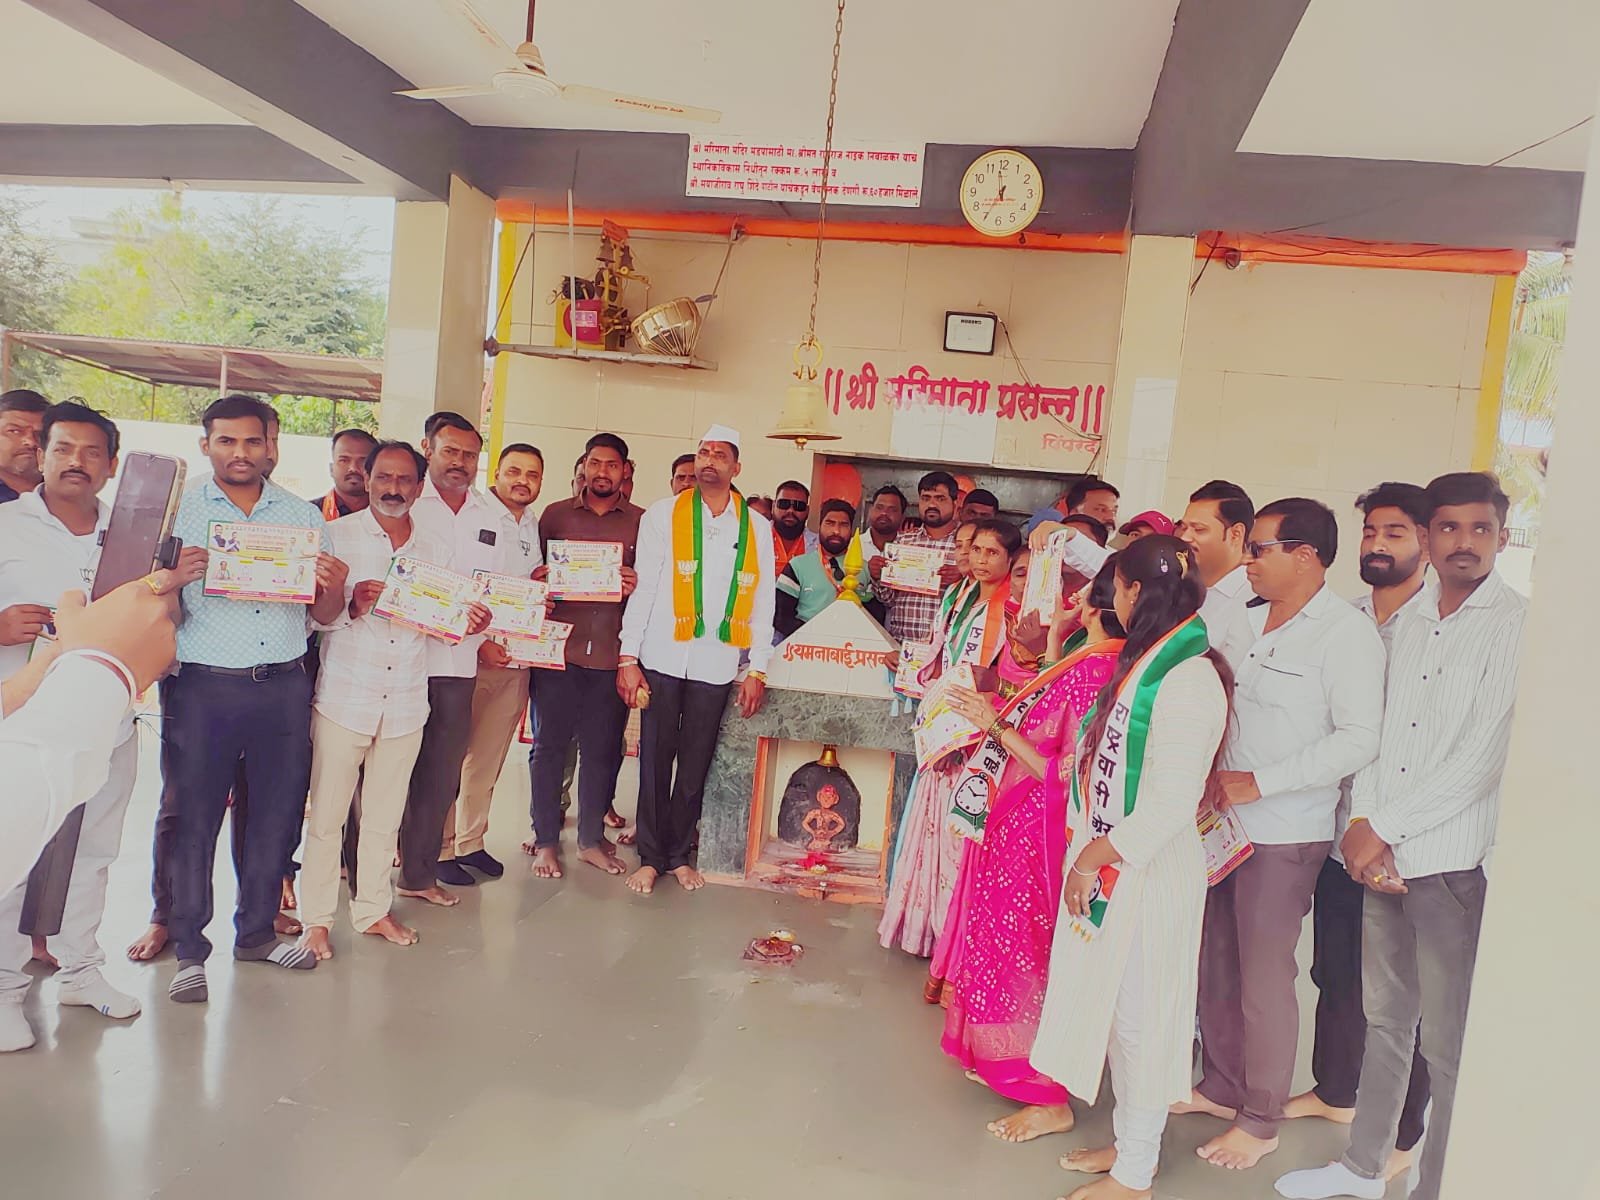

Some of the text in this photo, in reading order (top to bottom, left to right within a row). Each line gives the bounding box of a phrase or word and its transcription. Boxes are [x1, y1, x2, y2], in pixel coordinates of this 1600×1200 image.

[986, 163, 995, 174] 11
[1000, 160, 1010, 170] 12
[1016, 164, 1020, 175] 1
[975, 174, 984, 184] 10
[1024, 174, 1030, 184] 2
[970, 187, 977, 198] 9
[1027, 189, 1033, 199] 3
[973, 201, 980, 211] 8
[1020, 203, 1027, 211] 4
[983, 212, 989, 221] 7
[995, 216, 1002, 227] 6
[1009, 212, 1016, 223] 5
